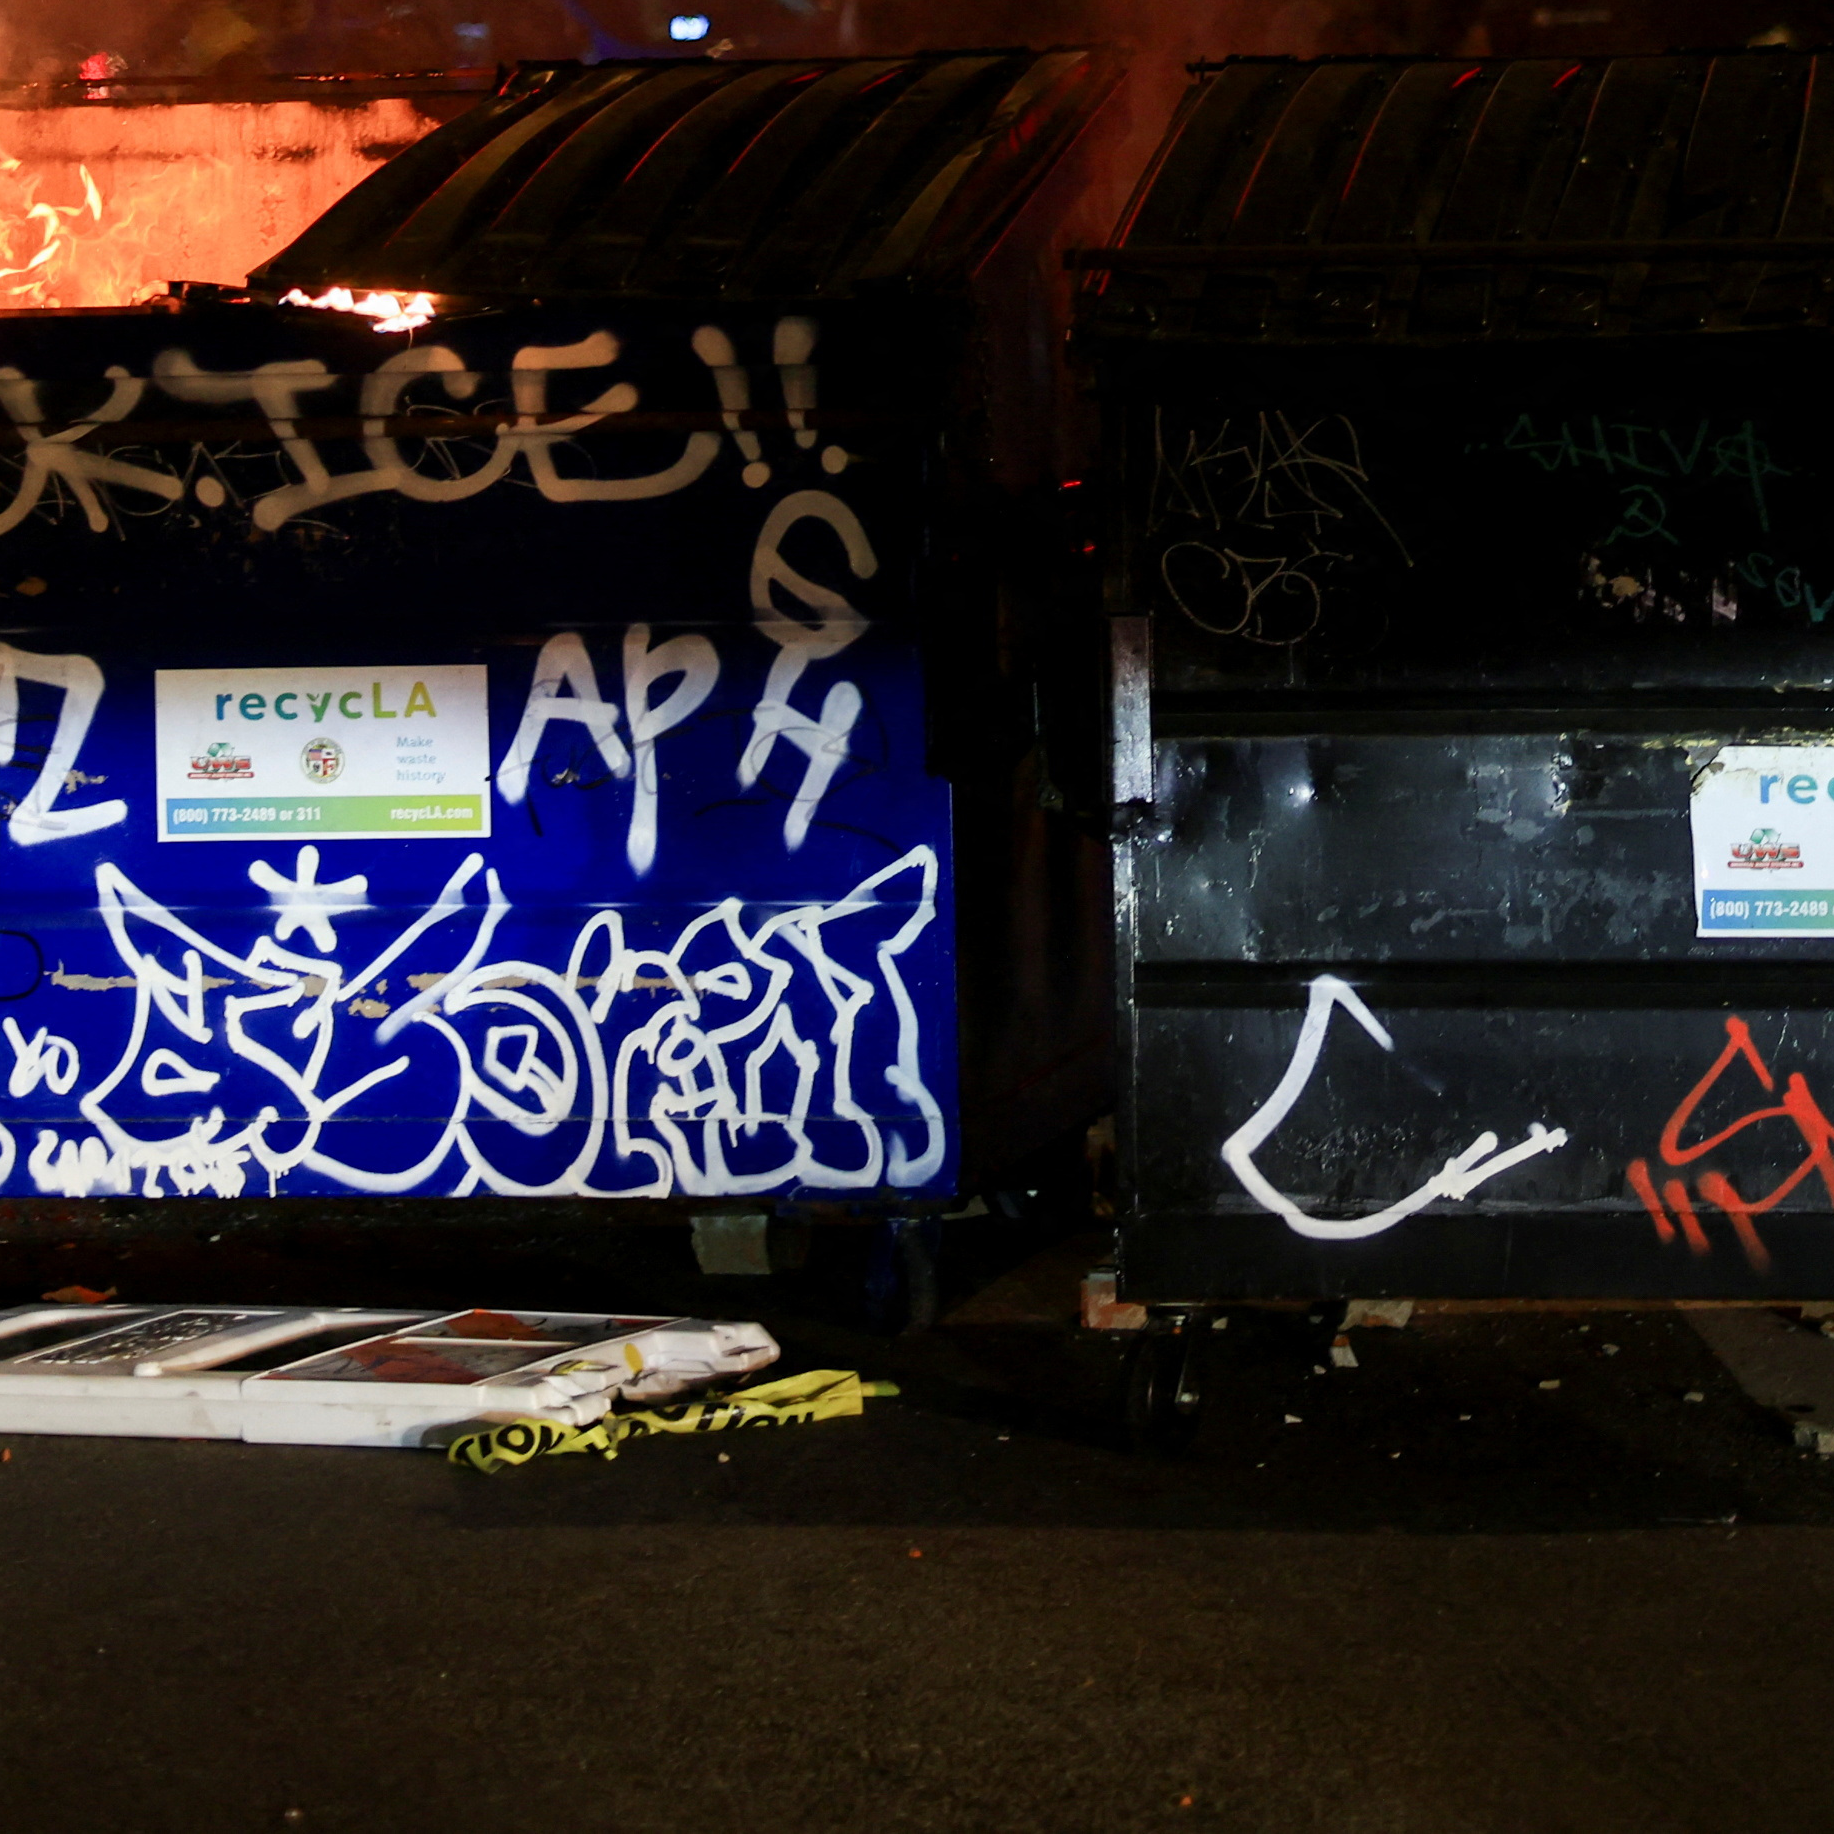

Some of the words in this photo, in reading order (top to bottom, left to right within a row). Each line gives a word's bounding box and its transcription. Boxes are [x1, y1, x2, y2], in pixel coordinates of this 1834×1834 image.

[214, 680, 438, 724] recycLA
[396, 735, 434, 749] Make
[396, 753, 437, 766] waste
[396, 768, 447, 784] history
[279, 809, 295, 822] or
[296, 806, 322, 821] 311
[1709, 900, 1750, 920] (800)
[1753, 900, 1829, 918] 773-2489
[2, 1016, 80, 1098] YO
